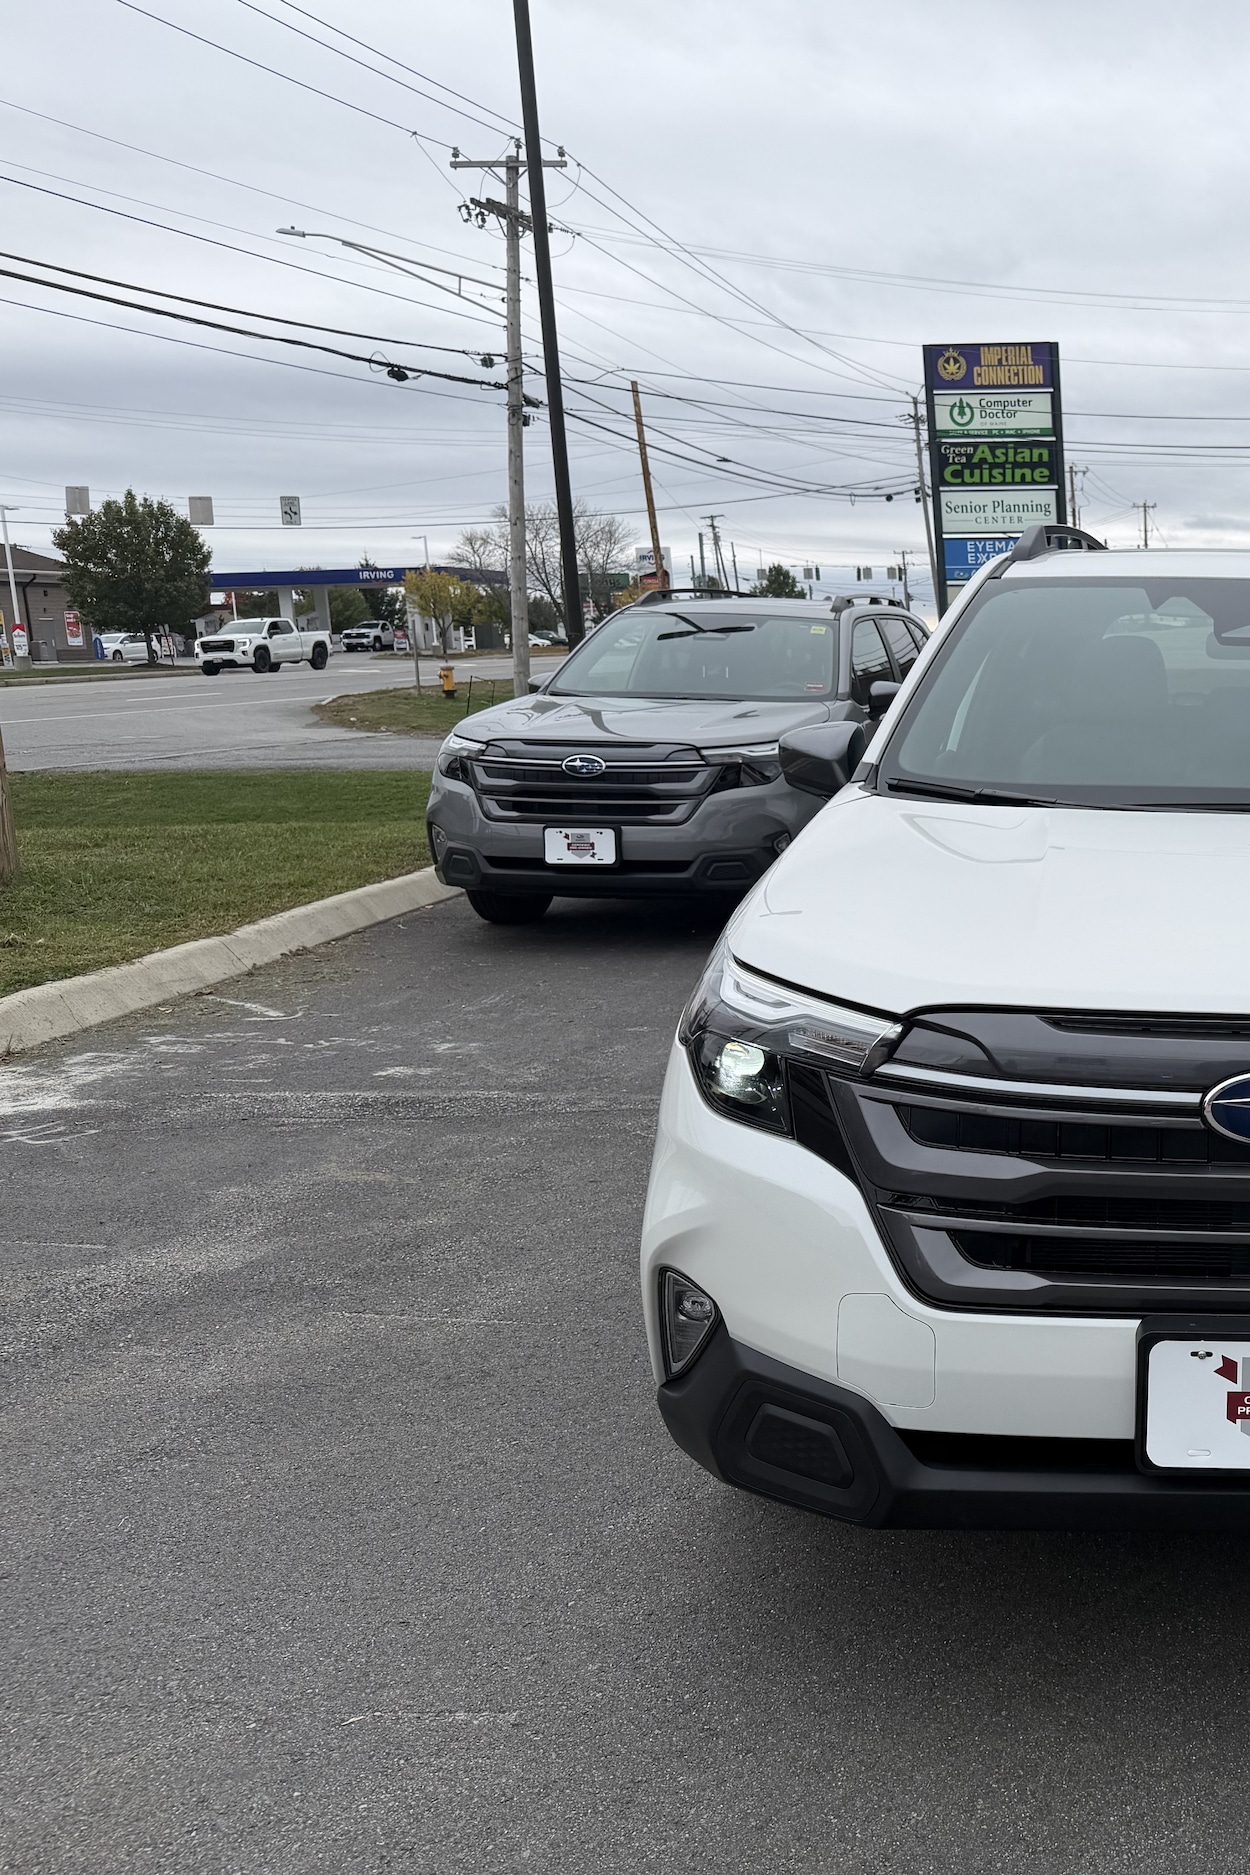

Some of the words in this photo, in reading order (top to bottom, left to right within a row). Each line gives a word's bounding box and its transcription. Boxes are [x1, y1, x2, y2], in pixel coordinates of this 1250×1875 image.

[980, 346, 1034, 365] IMPERIAL
[973, 365, 1043, 386] CONNECTION
[979, 398, 1033, 408] Computer
[979, 409, 1018, 419] Doctor
[941, 445, 974, 455] Green
[972, 444, 1049, 463] Asian
[947, 453, 967, 464] Tea
[943, 464, 1050, 484] Cuisine
[945, 501, 988, 514] Senior
[992, 500, 1052, 516] Planning
[975, 516, 1024, 524] CENTER
[967, 541, 1016, 552] EYEMA
[359, 570, 395, 580] IRVING
